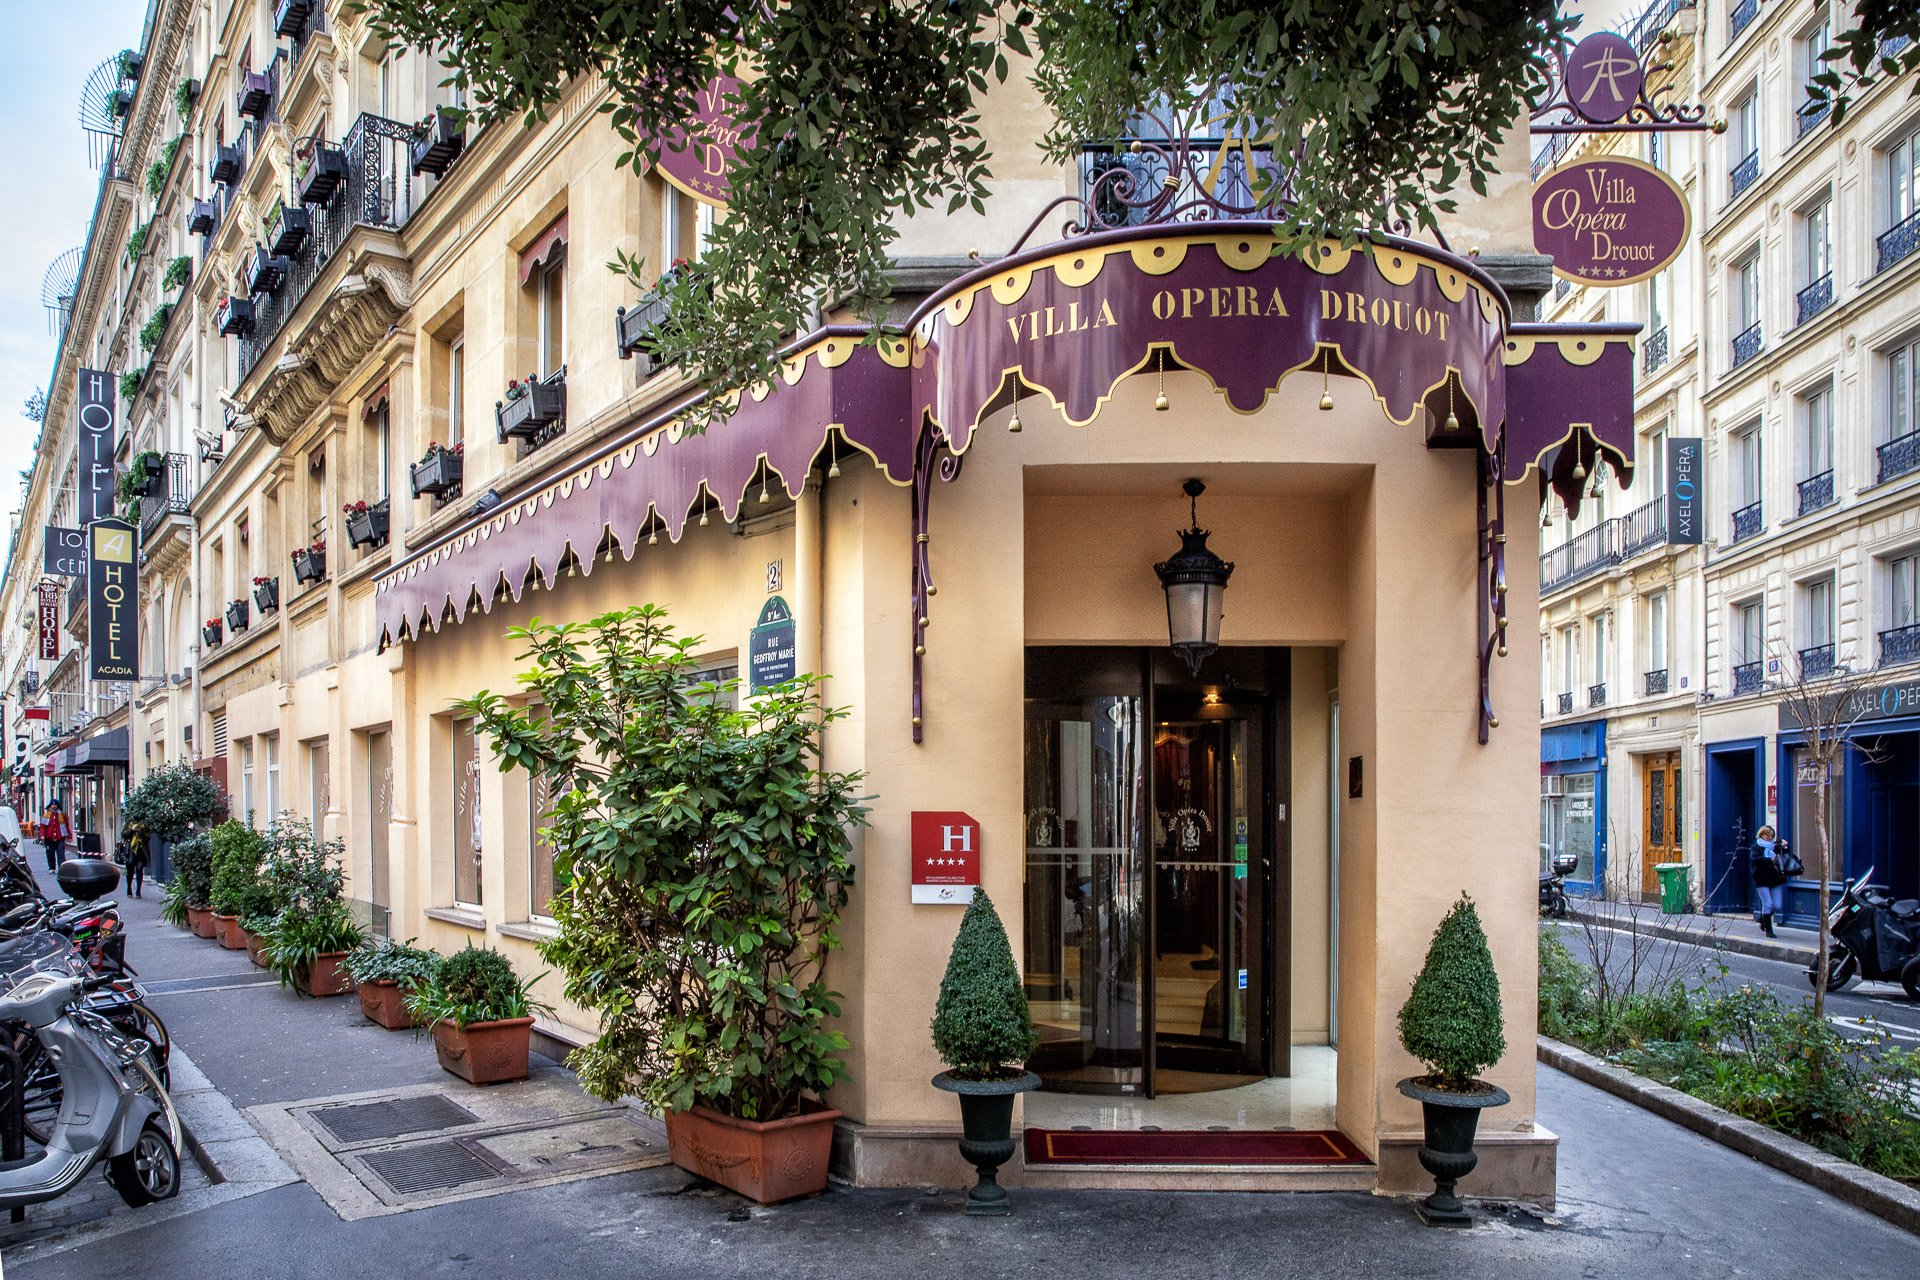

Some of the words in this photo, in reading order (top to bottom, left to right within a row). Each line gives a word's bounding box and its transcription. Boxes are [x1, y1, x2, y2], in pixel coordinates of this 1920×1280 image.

[1586, 168, 1636, 204] Villa
[1542, 188, 1628, 241] Opéra
[1591, 231, 1655, 261] Drouot
[1006, 297, 1118, 344] VILLA
[1152, 286, 1290, 320] OPERA
[1320, 289, 1451, 341] DROUOT
[80, 374, 113, 520] HOTEL
[769, 566, 777, 585] 2
[103, 565, 125, 660] HOTEL
[42, 606, 56, 659] HOTEL
[767, 637, 779, 648] RUE
[98, 666, 133, 675] ACADIA
[753, 650, 777, 665] GEOFFROY
[940, 825, 973, 852] H
